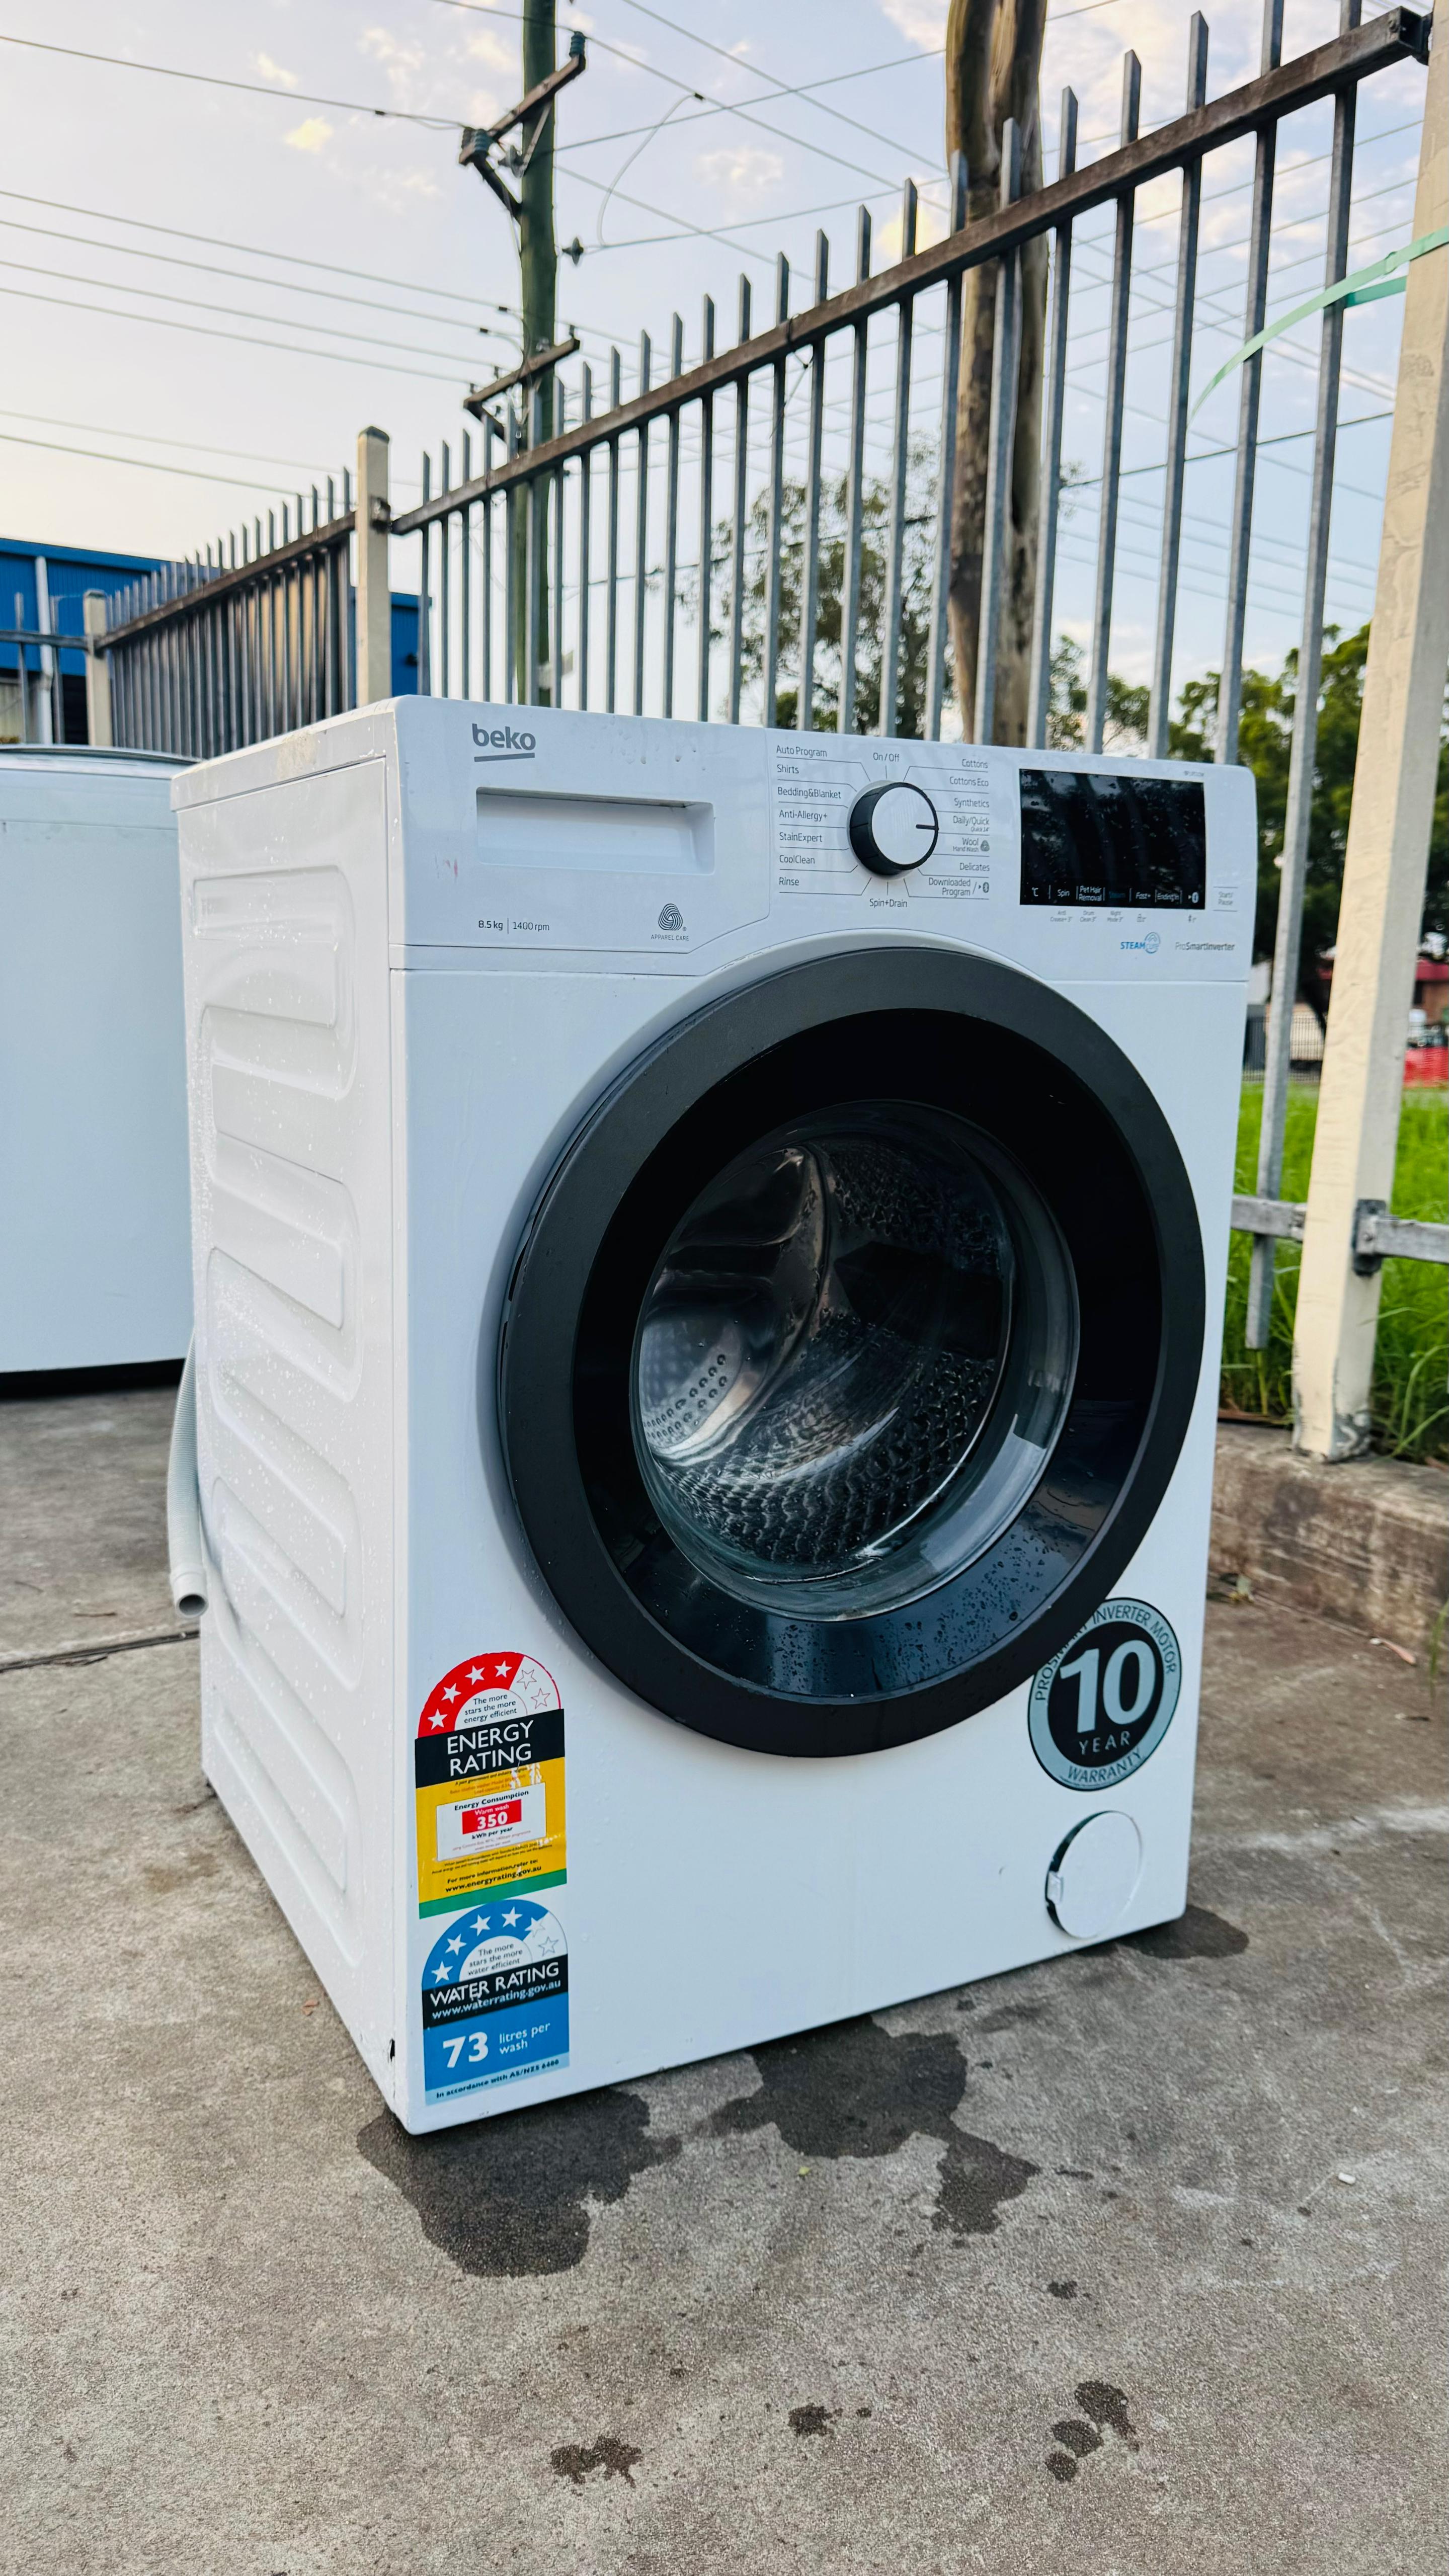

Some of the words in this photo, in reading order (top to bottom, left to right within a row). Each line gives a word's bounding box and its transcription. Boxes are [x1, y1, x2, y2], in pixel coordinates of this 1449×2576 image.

[472, 723, 536, 750] beko
[776, 745, 794, 755] Auto
[795, 747, 827, 758] Program
[777, 765, 799, 774] Shirts
[962, 759, 988, 769] Cottons
[949, 777, 976, 786] Cottons
[977, 779, 989, 787] Eco
[778, 787, 841, 799] Bedding&Blanket
[954, 798, 990, 809] Synthetics
[779, 810, 828, 822] Anti-Allergy+
[953, 816, 990, 826] Daily/Quick
[779, 832, 823, 843] StainExpert
[962, 837, 979, 845] Wool
[779, 855, 815, 864] CoolClean
[959, 863, 990, 872] Delicates
[779, 877, 799, 886] Rinse
[929, 877, 971, 887] Downloaded
[942, 888, 971, 898] Program
[1057, 889, 1070, 897] Spin
[869, 899, 908, 910] Spin+Drain
[478, 920, 492, 928] 8.5
[494, 921, 503, 931] kg
[513, 922, 533, 930] 1400
[1092, 1604, 1151, 1626] INVERTER
[1150, 1621, 1176, 1674] MOTOR
[1060, 1639, 1156, 1734] 10
[464, 1715, 488, 1723] energy
[490, 1708, 517, 1718] efficient
[447, 1720, 534, 1754] ENERGY
[1079, 1731, 1131, 1755] YEAR
[450, 1744, 531, 1777] RATING
[1068, 1748, 1144, 1783] WARRANTY
[454, 1802, 479, 1811] Energy
[481, 1791, 529, 1805] Consumption
[477, 1811, 508, 1830] 350
[445, 1866, 542, 1892] www.energyrating.gov.au
[459, 1873, 475, 1882] more
[478, 1949, 492, 1957] The
[495, 1944, 514, 1953] more
[469, 1959, 487, 1967] stars
[504, 1950, 523, 1959] more
[468, 1966, 489, 1975] water
[492, 1958, 520, 1970] efficient
[430, 1981, 489, 2006] WATER
[496, 1962, 559, 1994] RATING
[432, 1980, 561, 2020] www.waterrating.gov.au
[499, 2029, 527, 2044] litres
[531, 2022, 550, 2038] per
[443, 2031, 489, 2068] 73
[499, 2040, 528, 2055] wash
[446, 2080, 489, 2096] accordance
[491, 2074, 508, 2083] with
